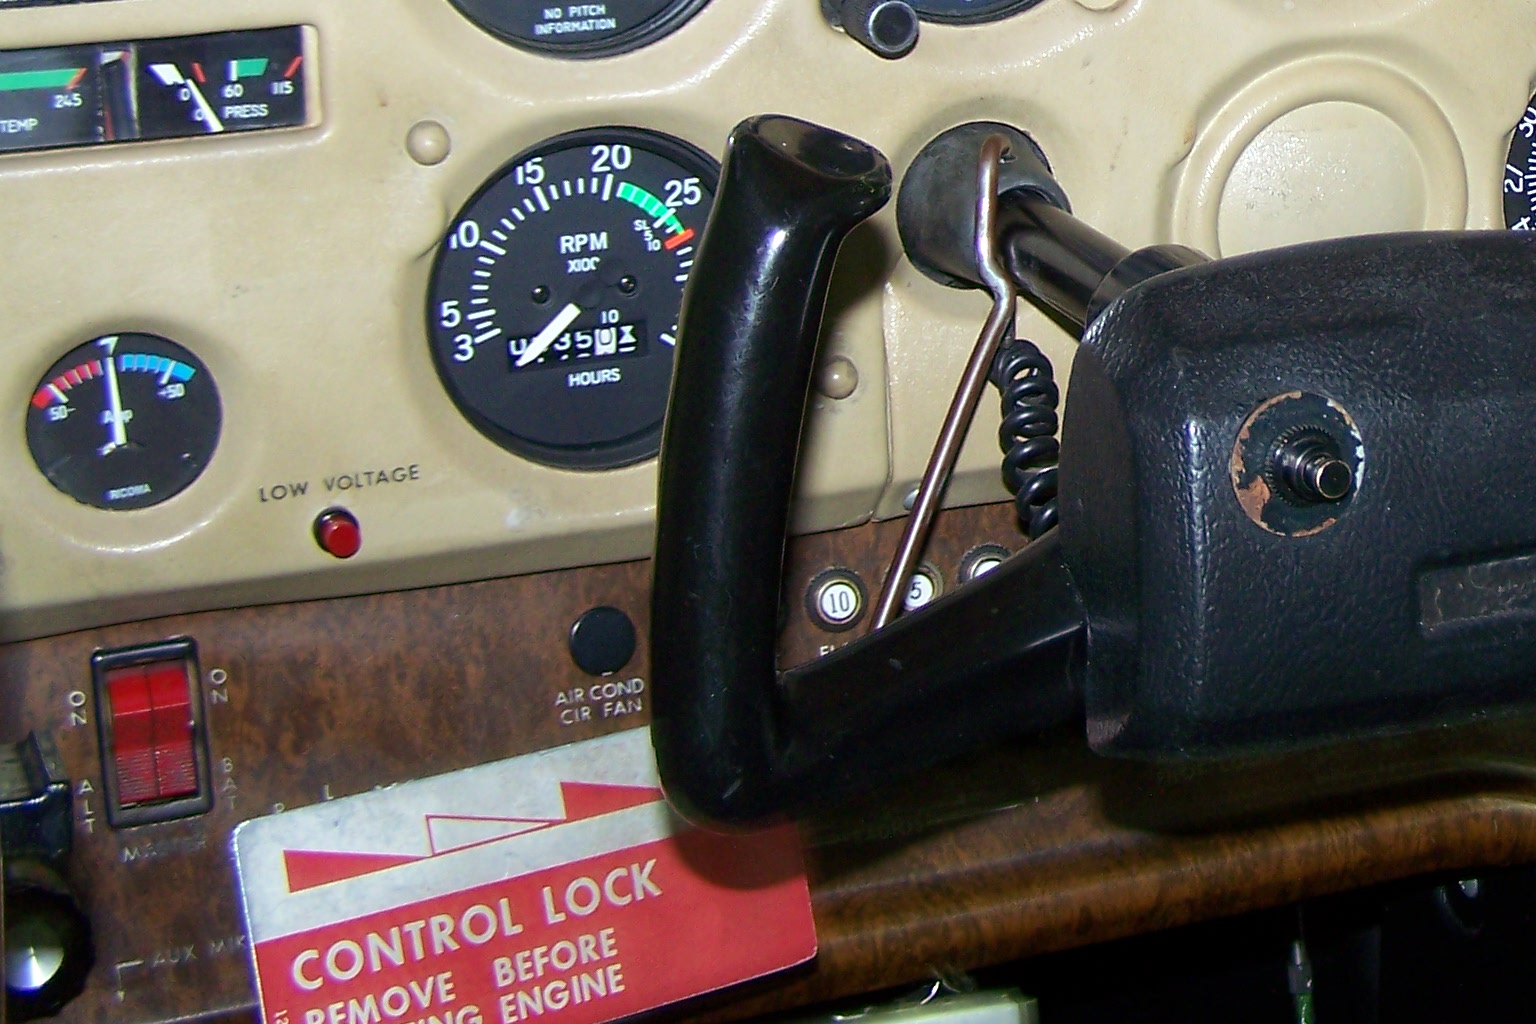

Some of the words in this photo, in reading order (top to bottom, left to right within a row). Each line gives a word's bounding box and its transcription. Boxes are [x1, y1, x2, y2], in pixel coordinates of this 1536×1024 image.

[544, 8, 561, 20] NO
[569, 4, 606, 17] PITCH
[535, 18, 616, 35] INFORMATION
[54, 93, 83, 108] 245
[225, 104, 269, 120] PRESS
[591, 144, 632, 174] 20
[664, 177, 701, 207] 25
[560, 231, 608, 254] RPM
[568, 367, 622, 387] HOURS
[259, 481, 309, 503] LOW
[322, 463, 421, 494] VOLTAGE
[830, 590, 850, 613] 10
[555, 689, 586, 707] AIR
[590, 676, 644, 701] COND
[560, 707, 593, 726] CIR
[604, 699, 643, 718] FAN
[291, 896, 524, 991] CONTROL
[543, 858, 663, 926] LOCK
[304, 971, 457, 1024] REMOVE
[492, 928, 620, 988] BEFORE
[500, 965, 627, 1023] ENGINE
